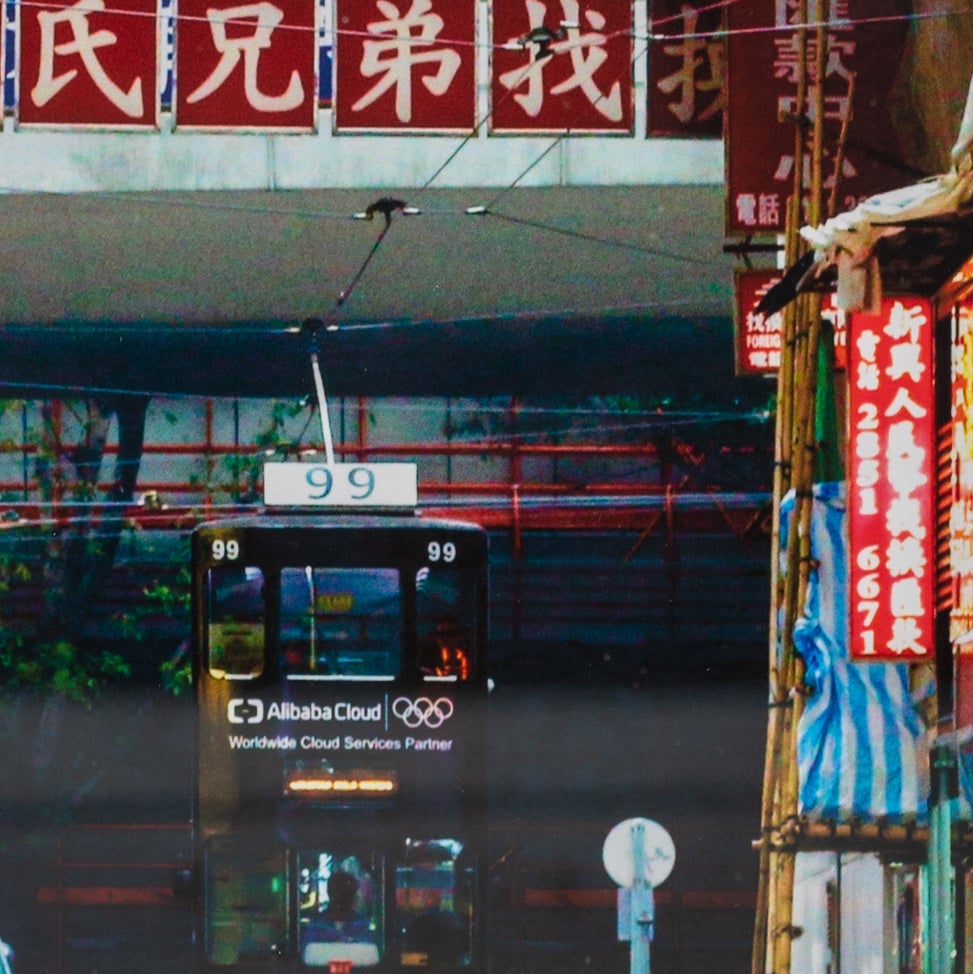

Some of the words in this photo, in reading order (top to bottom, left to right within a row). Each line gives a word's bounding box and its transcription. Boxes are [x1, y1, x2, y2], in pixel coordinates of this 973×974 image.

[736, 193, 780, 226] 電話
[305, 466, 376, 500] 99
[211, 539, 240, 561] 99
[427, 541, 457, 563] 99
[856, 545, 881, 656] 6671
[228, 735, 297, 750] Worldwide
[300, 736, 341, 750] Cloud
[344, 736, 402, 750] Services
[405, 737, 454, 751] Partner
